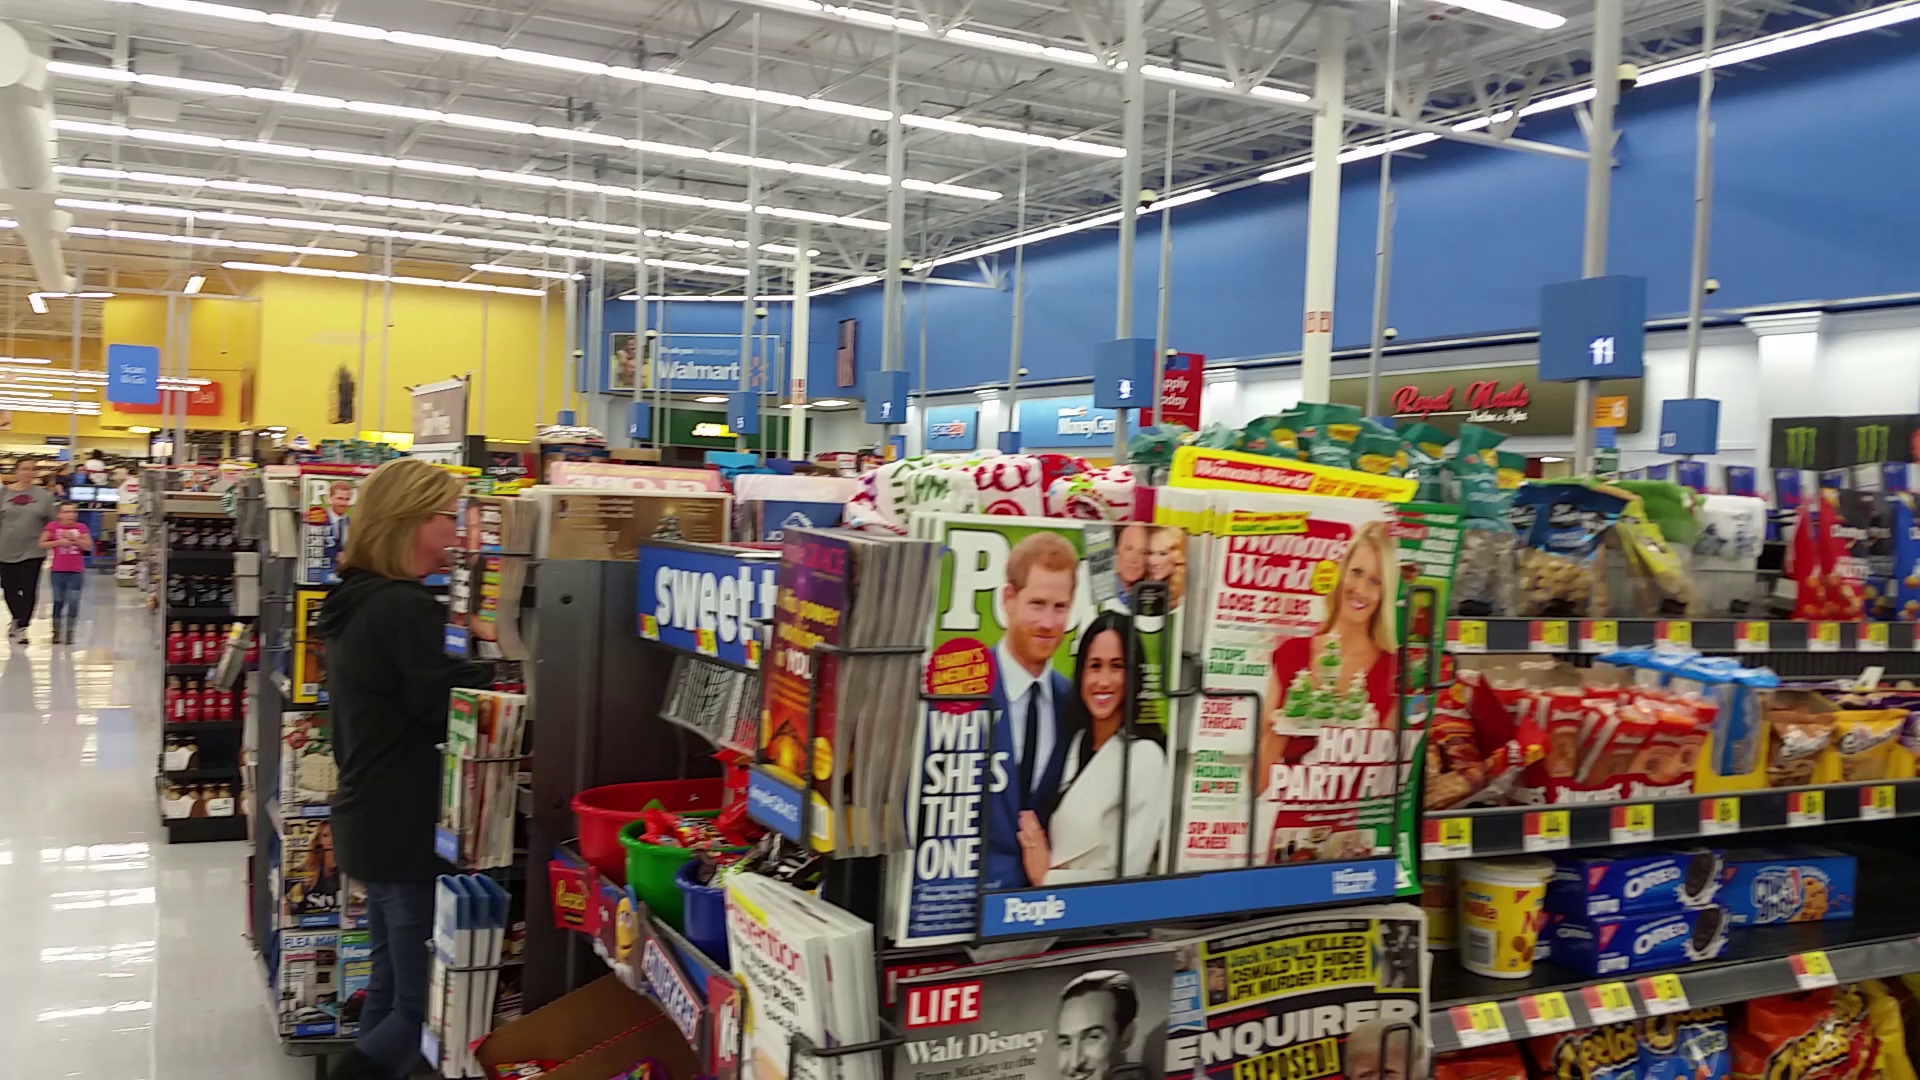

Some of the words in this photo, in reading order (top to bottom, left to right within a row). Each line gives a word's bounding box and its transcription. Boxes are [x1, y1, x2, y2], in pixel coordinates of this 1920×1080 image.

[1591, 337, 1616, 365] 11
[658, 360, 740, 381] Walmart
[1159, 378, 1189, 397] pply
[1391, 385, 1454, 420] Royal
[1464, 380, 1530, 409] Nails
[1231, 533, 1349, 562] Woman's
[1227, 553, 1315, 591] World
[656, 566, 755, 646] sweet
[1217, 592, 1256, 612] LOSE
[1260, 596, 1282, 614] 22
[931, 661, 989, 686] AMERICAN
[1268, 763, 1361, 802] PARTY
[921, 795, 982, 837] THE
[917, 837, 982, 881] ONE
[1624, 866, 1681, 898] OREO
[1003, 895, 1066, 926] People
[1304, 936, 1366, 952] KILLED
[1634, 922, 1690, 955] OREO
[909, 984, 981, 1026] LIFE
[904, 1037, 964, 1065] Walt
[968, 1029, 1048, 1058] Disney
[1164, 1000, 1419, 1073] ENQUIRER
